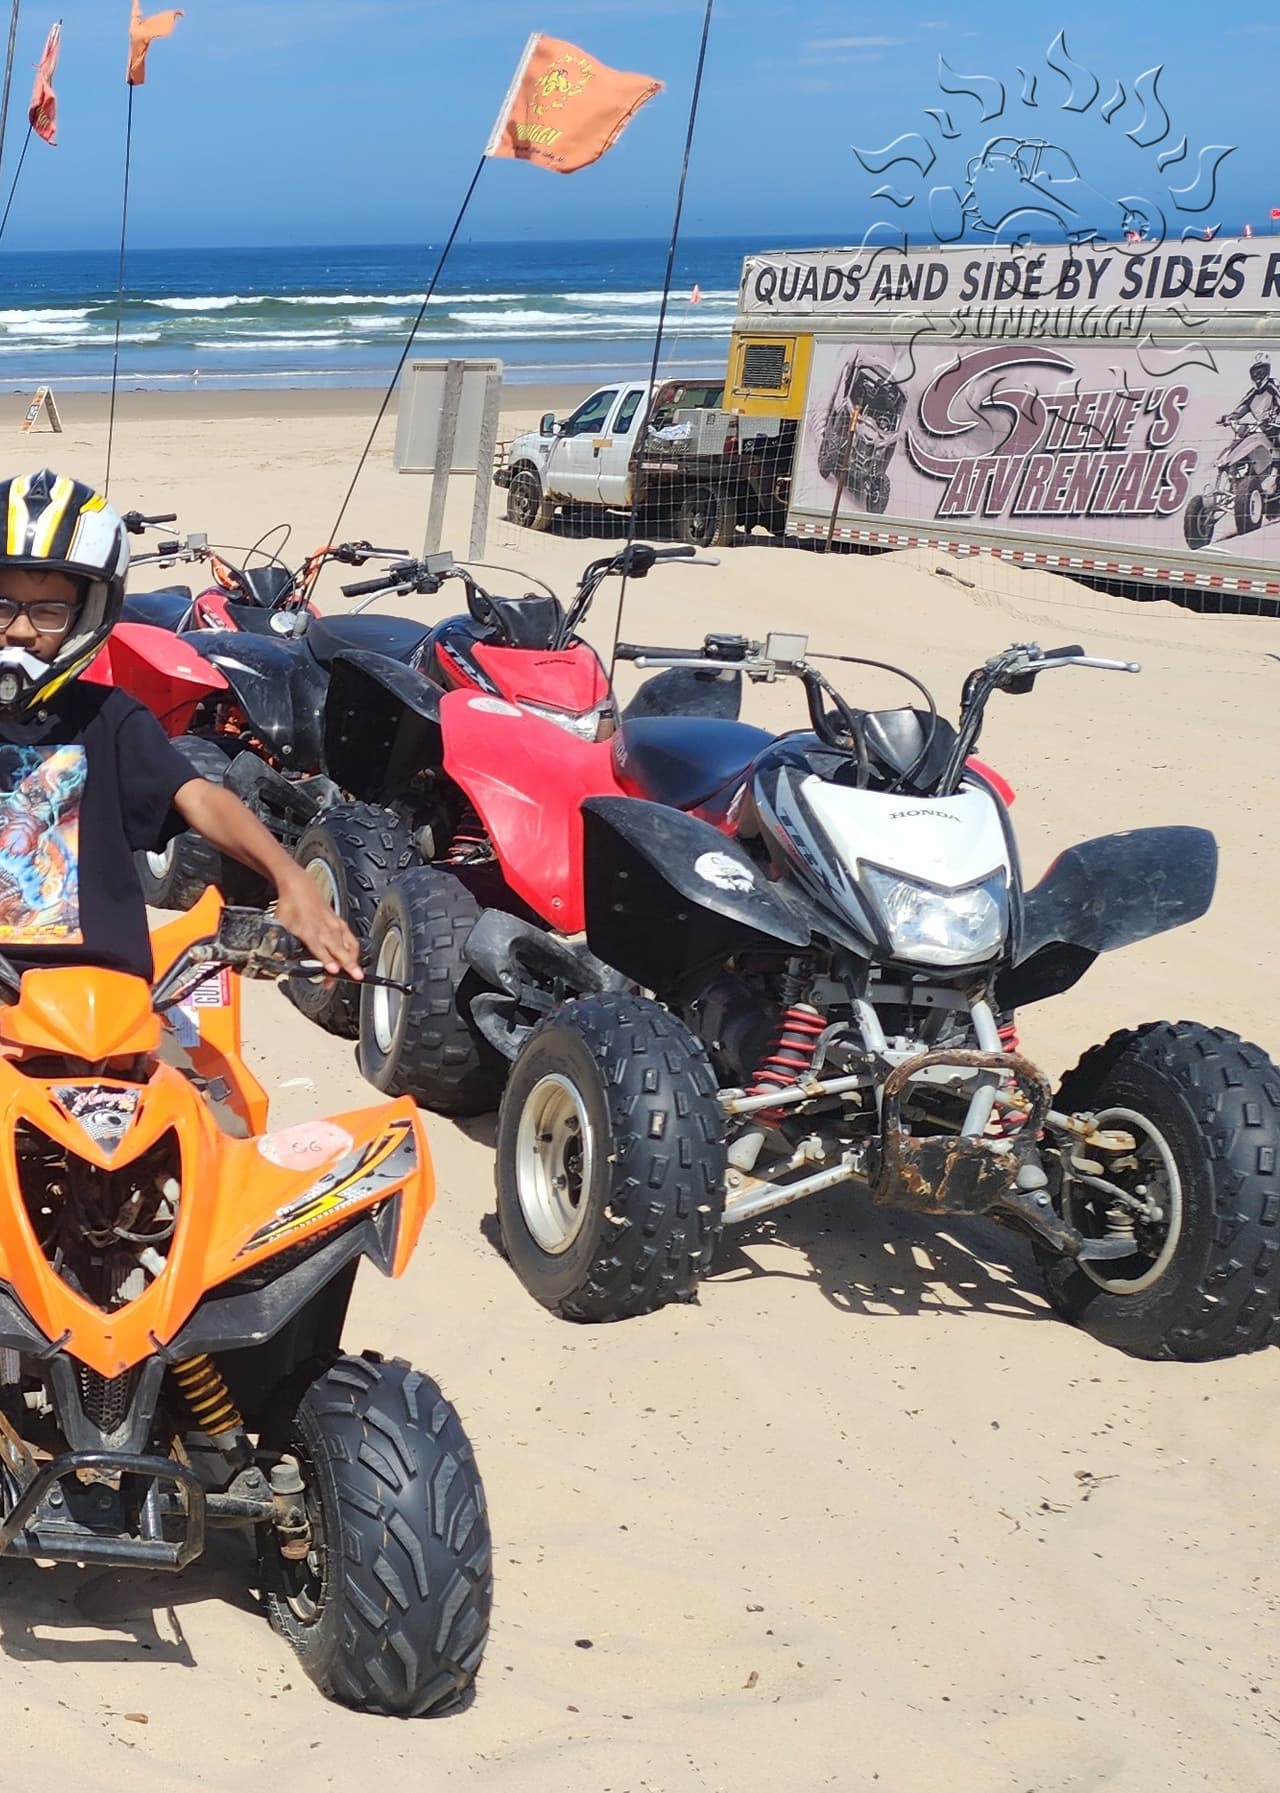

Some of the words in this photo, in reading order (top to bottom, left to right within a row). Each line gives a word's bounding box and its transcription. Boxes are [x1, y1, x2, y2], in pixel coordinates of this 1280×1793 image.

[755, 264, 863, 305] QUADS
[870, 263, 949, 301] AND
[959, 260, 1046, 301] SIDE
[1056, 257, 1113, 300] BY
[1119, 254, 1246, 300] SIDES
[906, 345, 1191, 480] STEVE'S
[937, 455, 1028, 517] ATV
[1011, 449, 1199, 517] RENTALS
[889, 809, 962, 823] HONDA
